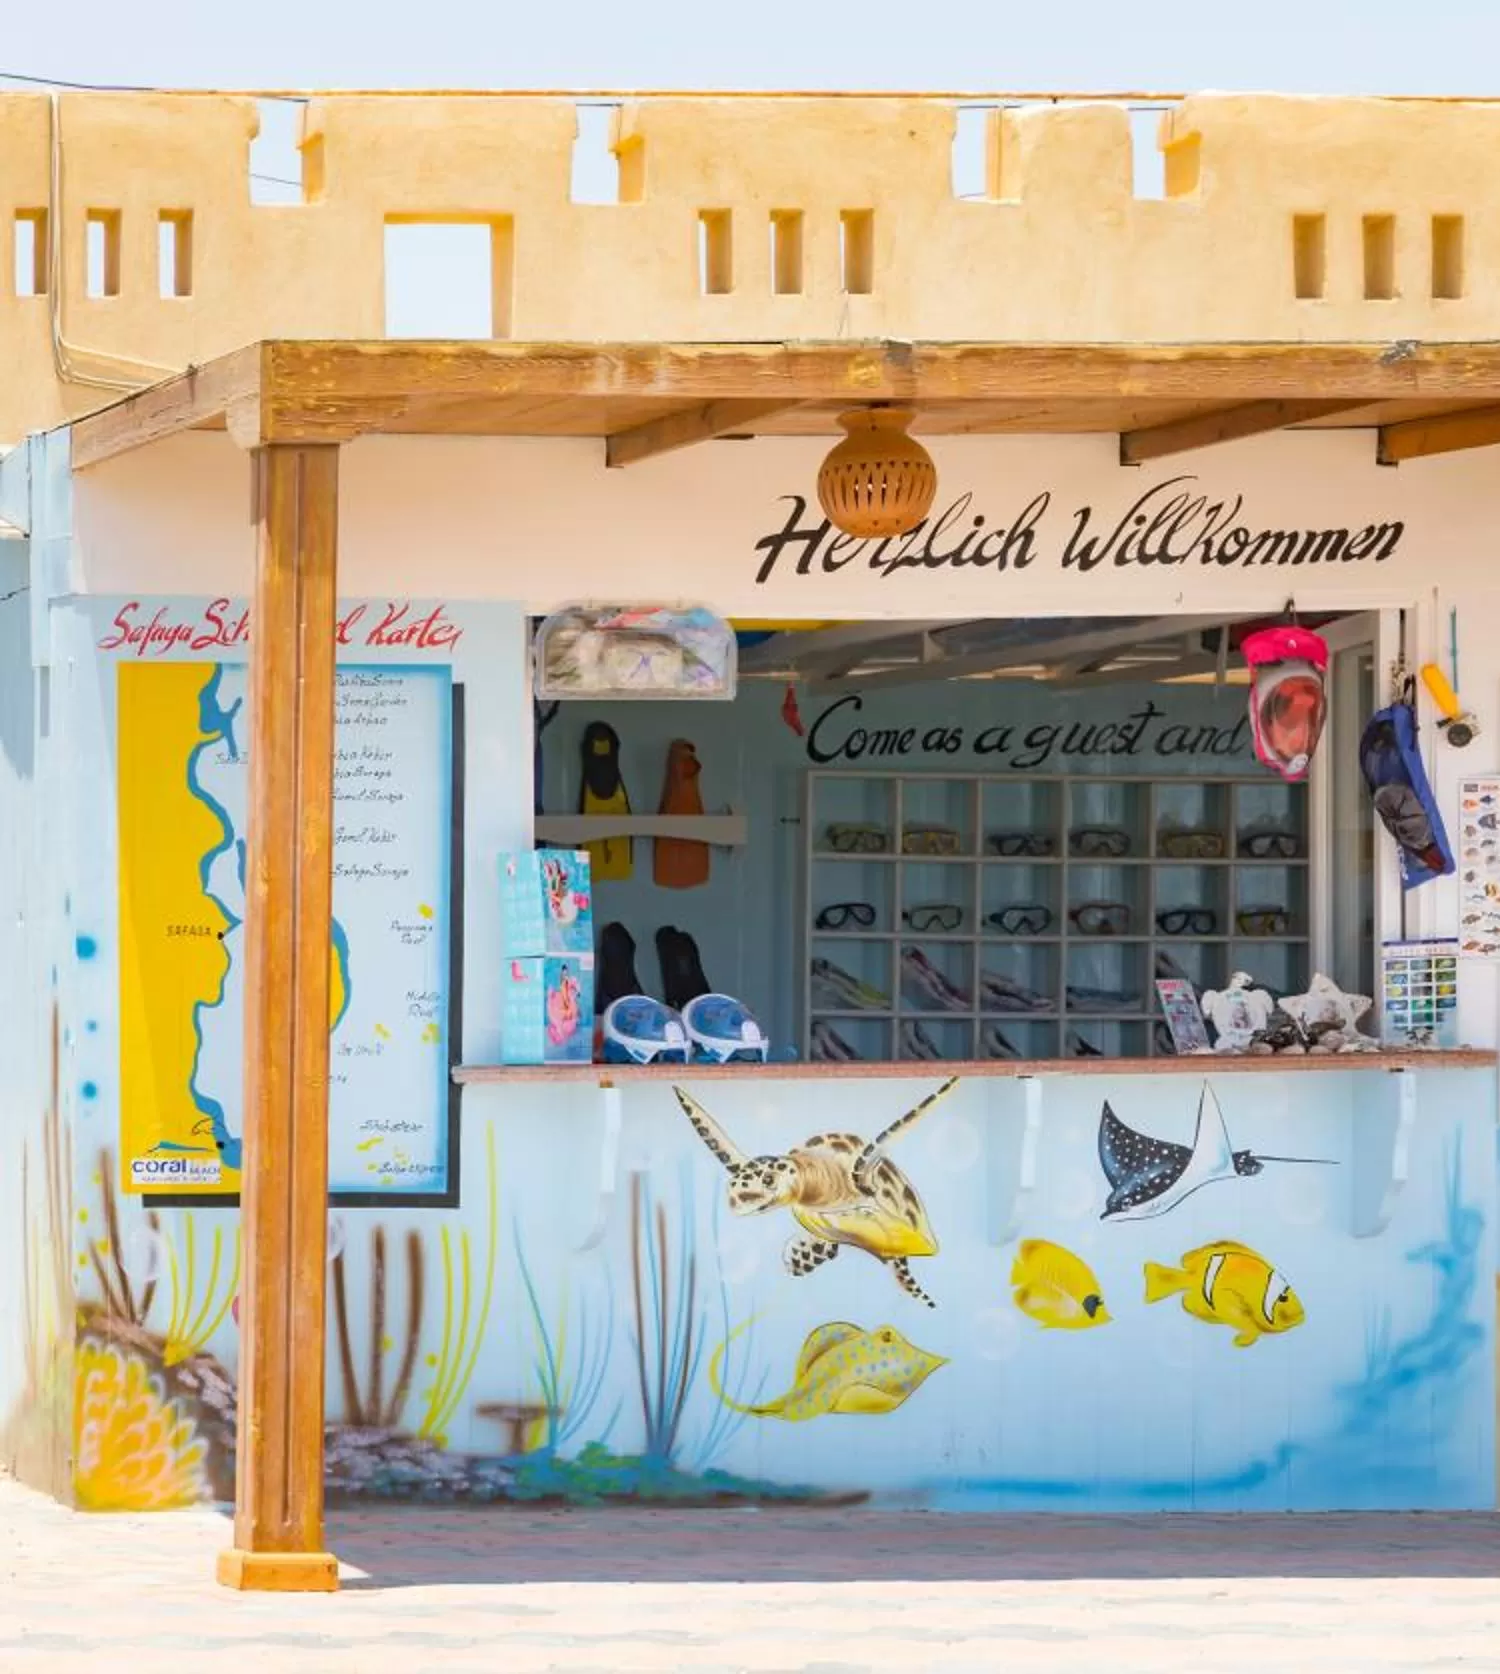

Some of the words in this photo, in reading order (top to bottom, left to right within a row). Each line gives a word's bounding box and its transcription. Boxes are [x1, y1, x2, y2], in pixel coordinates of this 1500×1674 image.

[754, 491, 1051, 583] Herzlich
[807, 695, 913, 764] Come
[922, 727, 965, 754] as
[973, 727, 1011, 754] a
[1009, 702, 1166, 768] guest
[1154, 717, 1248, 756] and
[132, 1158, 187, 1174] coral
